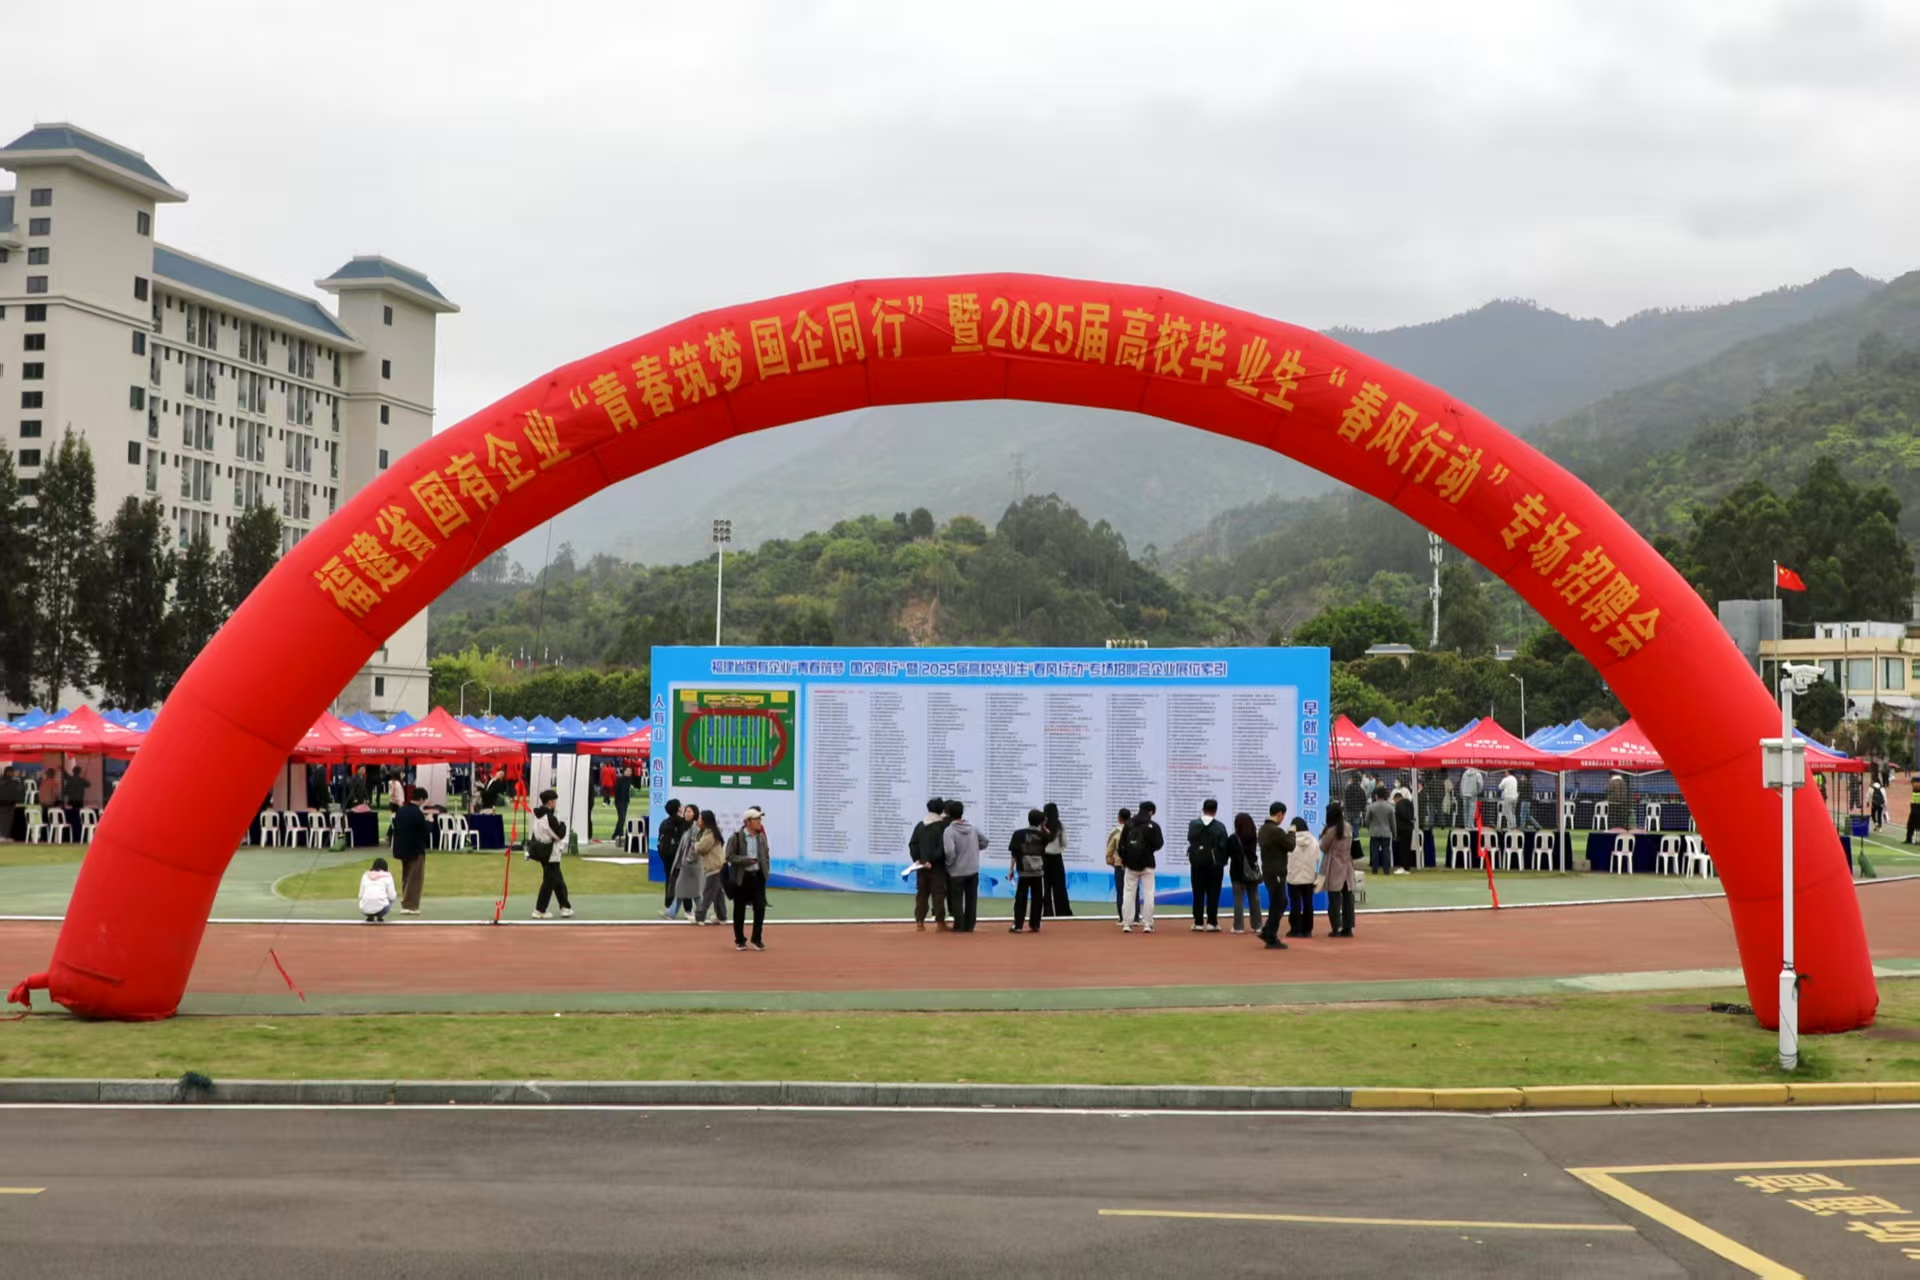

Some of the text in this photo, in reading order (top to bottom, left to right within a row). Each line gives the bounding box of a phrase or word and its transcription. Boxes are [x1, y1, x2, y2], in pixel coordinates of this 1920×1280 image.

[1302, 700, 1319, 826] 早就业 早起跑
[1733, 1172, 1920, 1260] 防通道
